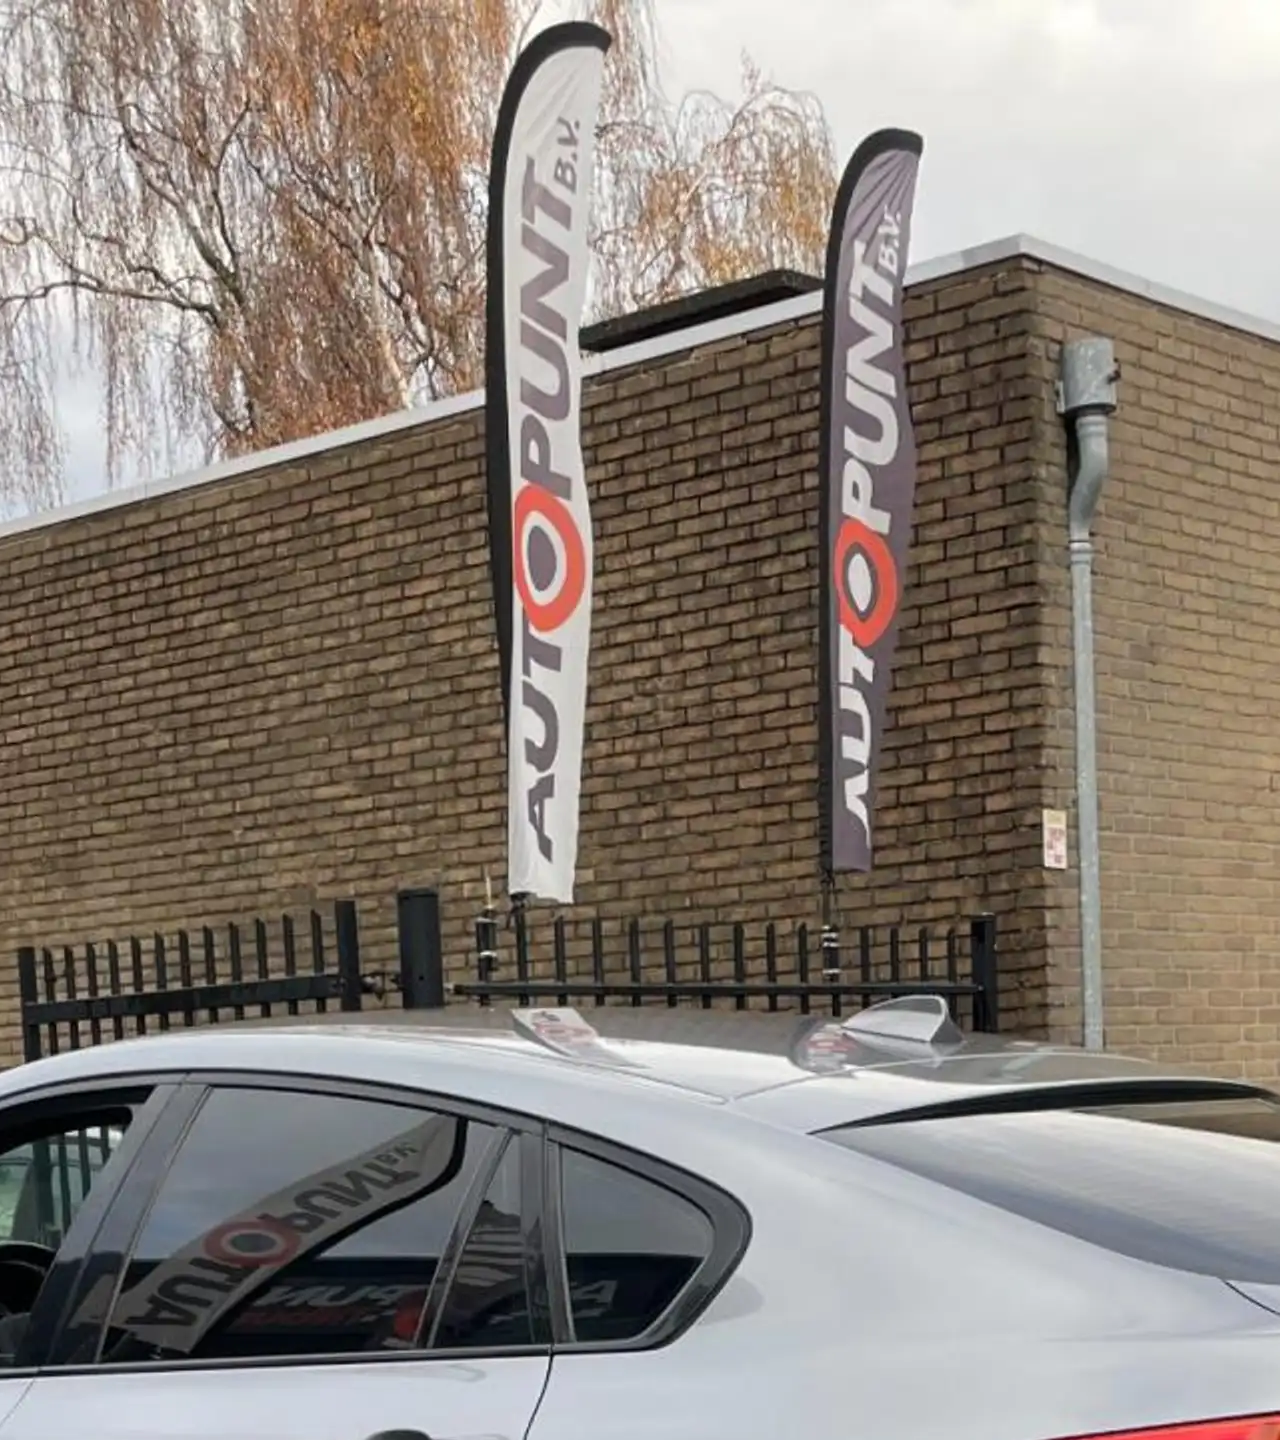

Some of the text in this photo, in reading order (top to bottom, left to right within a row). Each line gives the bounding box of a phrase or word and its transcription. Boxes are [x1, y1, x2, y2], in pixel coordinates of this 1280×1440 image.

[878, 204, 902, 277] B.V.
[514, 116, 586, 863] AUTOPUNT B.V.
